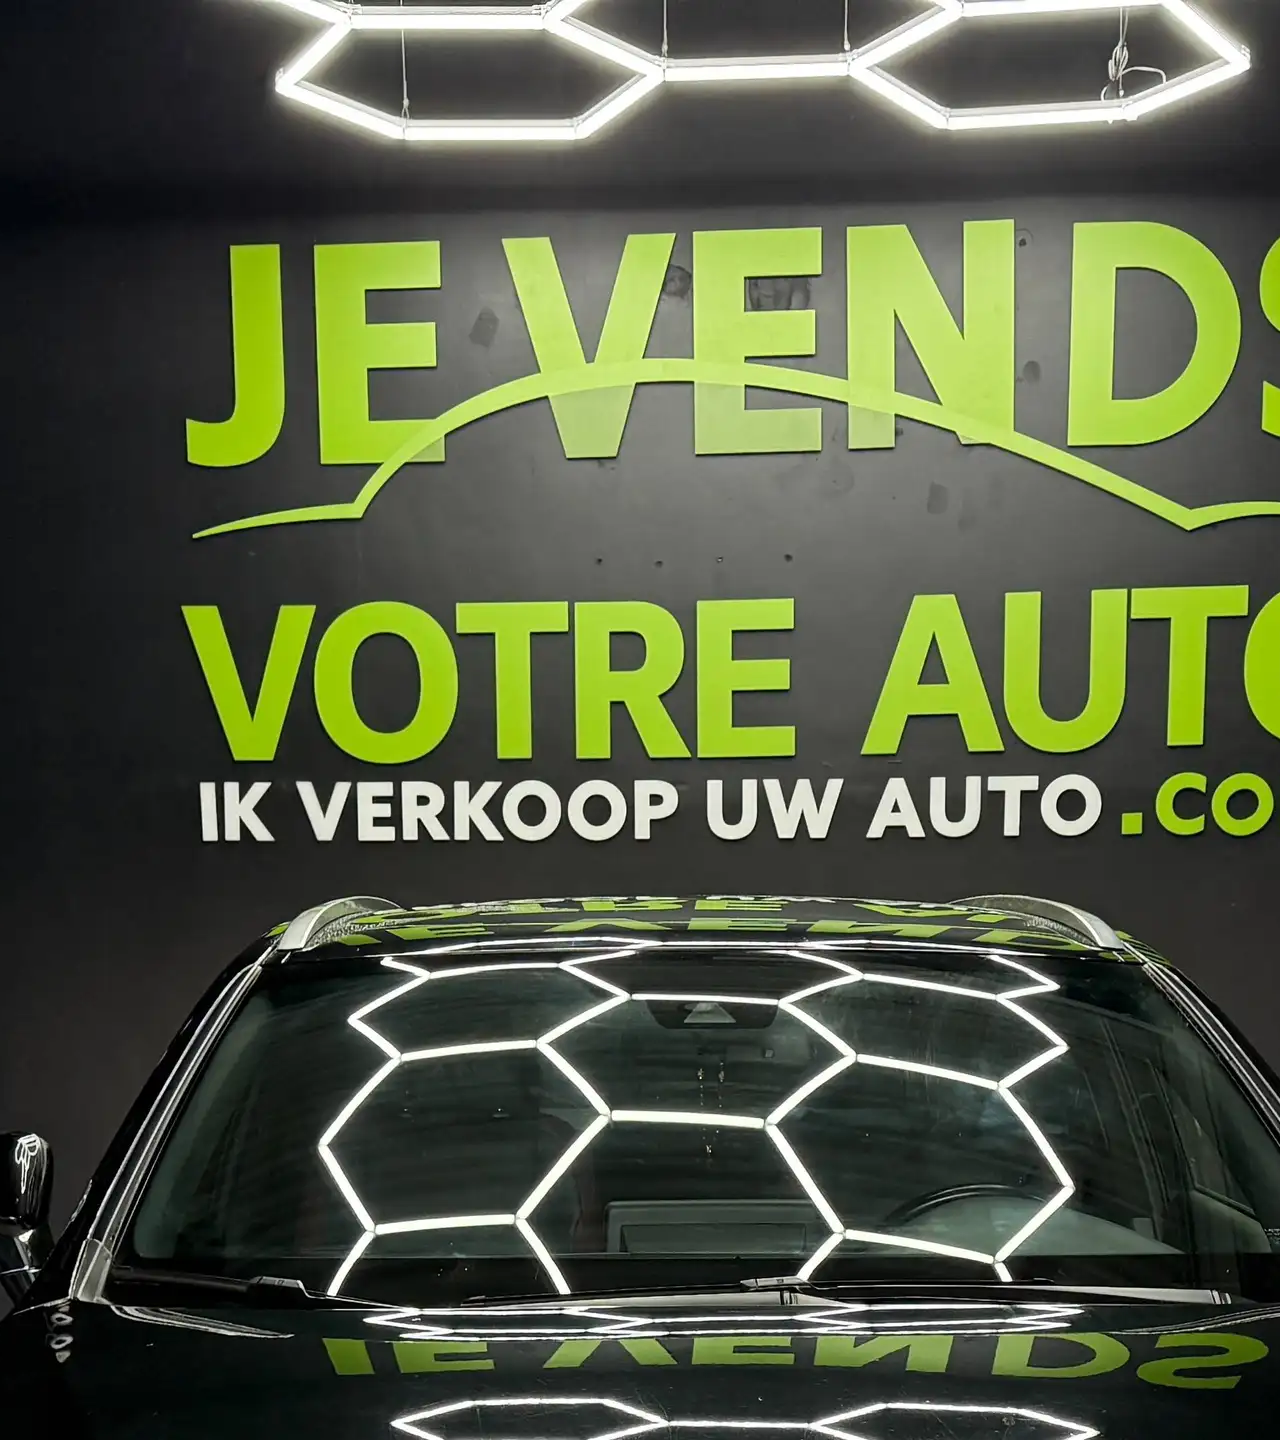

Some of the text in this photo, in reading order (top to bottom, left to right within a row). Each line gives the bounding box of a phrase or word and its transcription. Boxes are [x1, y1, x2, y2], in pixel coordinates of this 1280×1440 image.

[184, 240, 446, 467] JE
[181, 597, 796, 764] VOTRE
[199, 781, 275, 842] IK
[296, 779, 679, 842] VERKOOP
[706, 778, 845, 840] UW
[865, 773, 1102, 839] AUTO
